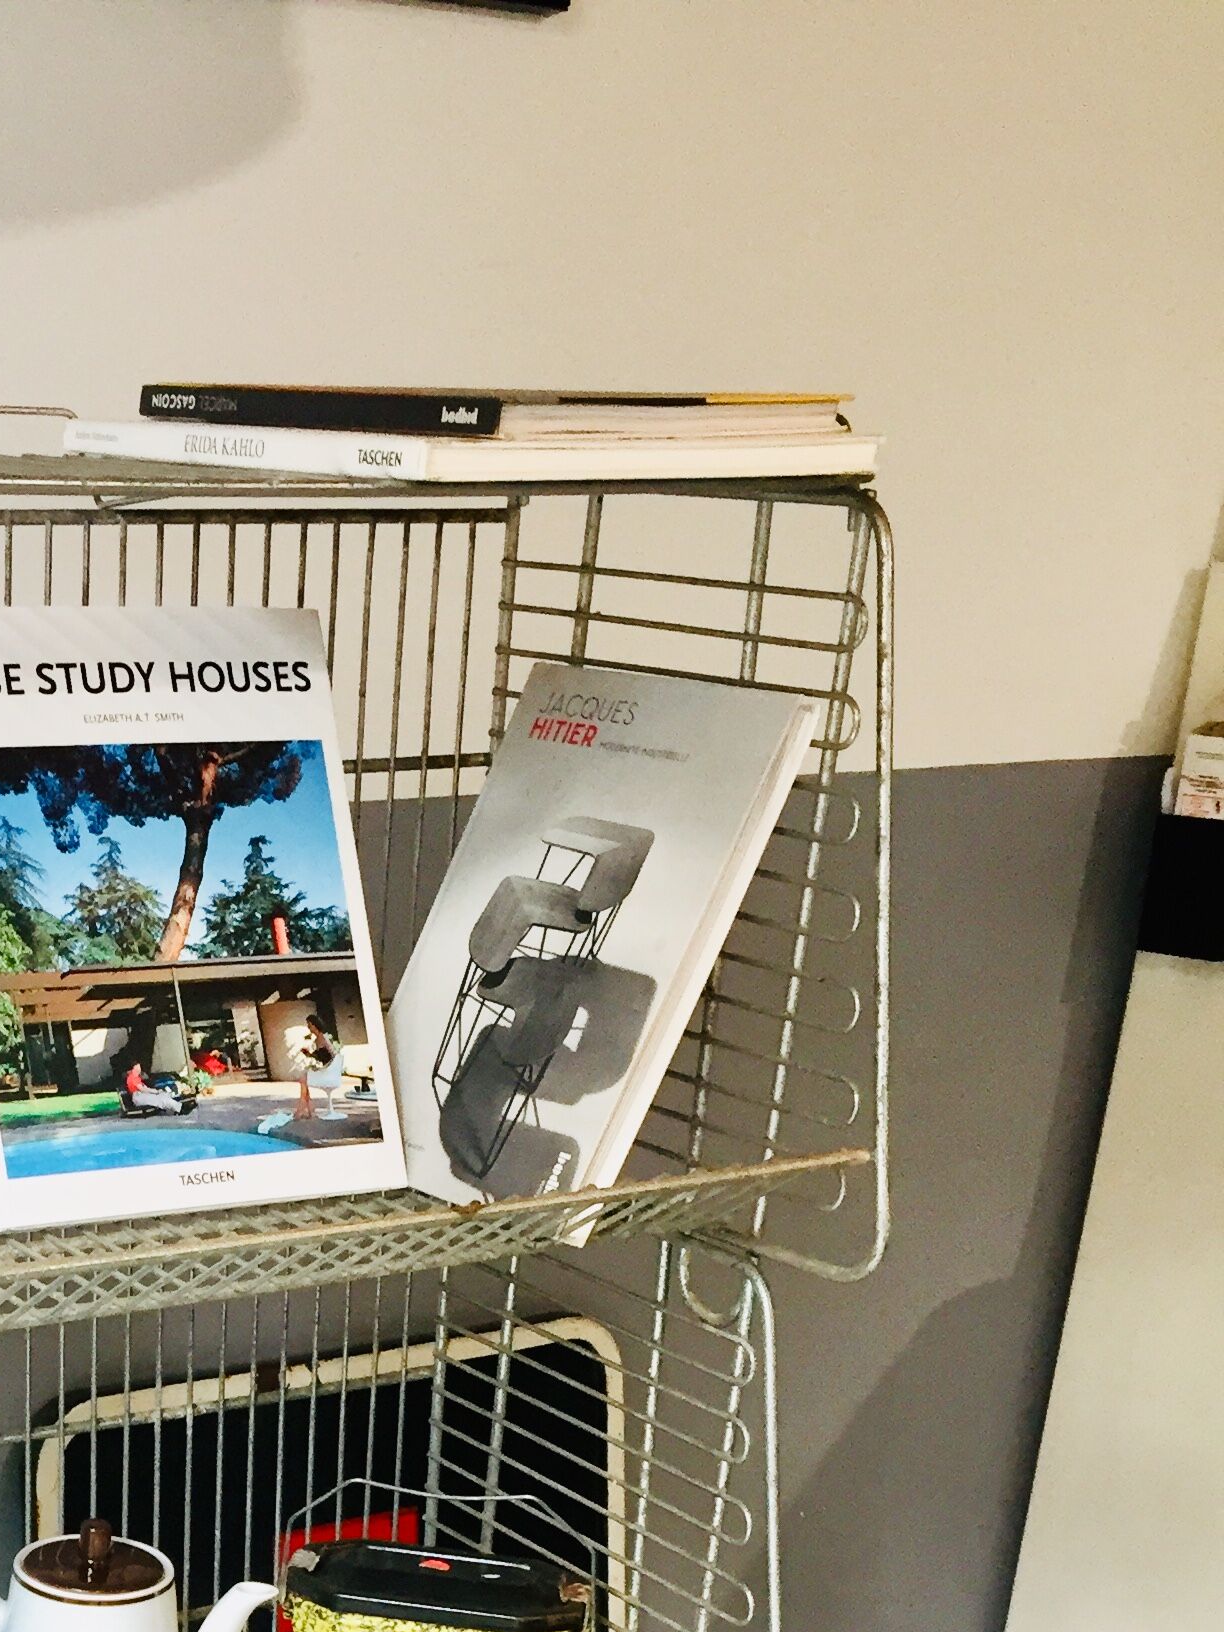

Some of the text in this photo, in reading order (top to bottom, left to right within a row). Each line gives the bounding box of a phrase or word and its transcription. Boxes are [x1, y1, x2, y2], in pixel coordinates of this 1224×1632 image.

[151, 393, 196, 410] GASCOIN
[183, 434, 265, 458] FRIDA KAHLO
[358, 449, 403, 467] TASCHEN
[35, 661, 155, 695] STUDY
[168, 661, 312, 693] HOUSES
[83, 713, 133, 724] ELIZABETH
[154, 712, 185, 722] SMITH
[539, 692, 640, 726] JACQUES
[528, 716, 600, 748] HITIER
[179, 1169, 235, 1187] TASCHEN
